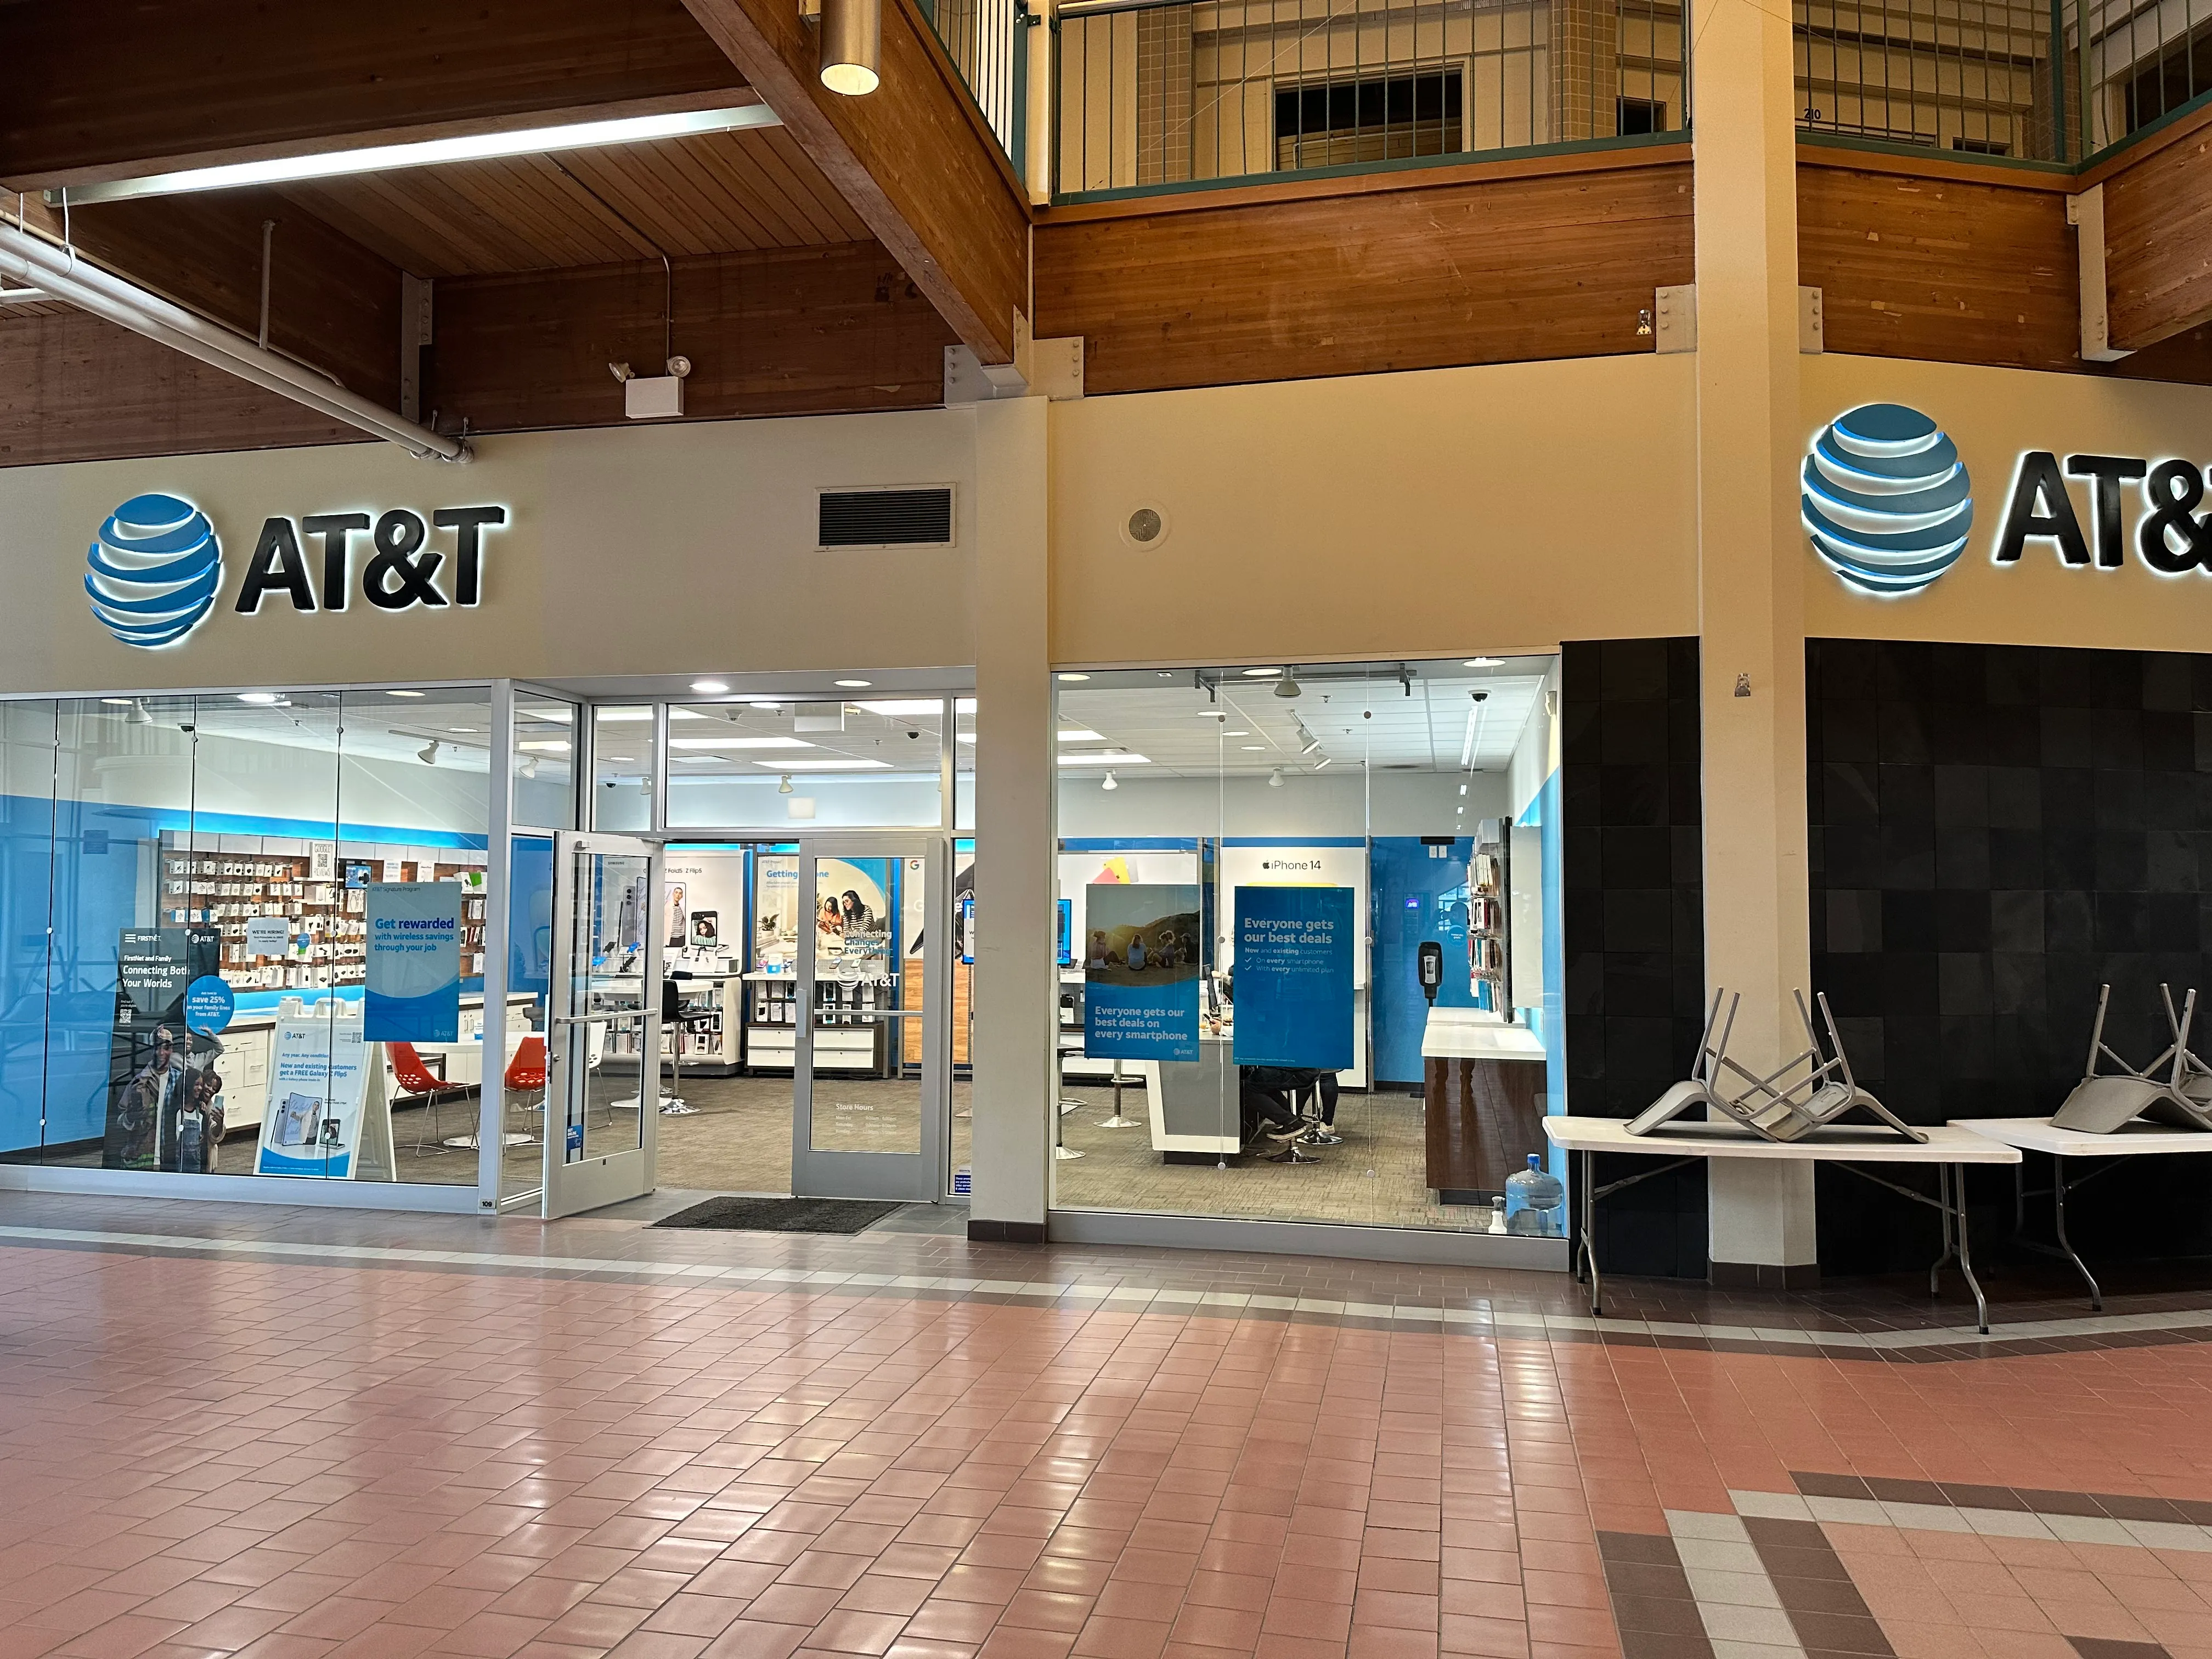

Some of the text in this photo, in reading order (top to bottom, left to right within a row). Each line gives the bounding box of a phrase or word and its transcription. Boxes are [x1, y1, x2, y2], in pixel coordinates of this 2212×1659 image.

[1804, 108, 1821, 120] 210
[1995, 451, 2212, 573] AT&
[235, 505, 506, 613] AT&T
[1271, 860, 1322, 870] iPhone 14
[766, 870, 798, 879] Getting
[375, 917, 454, 929] Get rewarded
[1244, 918, 1334, 932] Everyone gets
[425, 933, 454, 941] savings
[845, 930, 892, 939] Connecting
[1244, 932, 1332, 944] our best deals
[374, 944, 404, 952] through
[424, 944, 437, 952] job
[844, 939, 880, 947] Changes
[1273, 947, 1299, 955] existing
[123, 966, 190, 976] Connecting Both
[122, 978, 172, 988] Your Worlds
[861, 972, 900, 987] AT&T
[1095, 1006, 1141, 1017] Everyone
[1143, 1008, 1165, 1018] gets
[1095, 1017, 1117, 1026] best
[1119, 1018, 1145, 1028] deals
[1094, 1031, 1188, 1041] every smartphone
